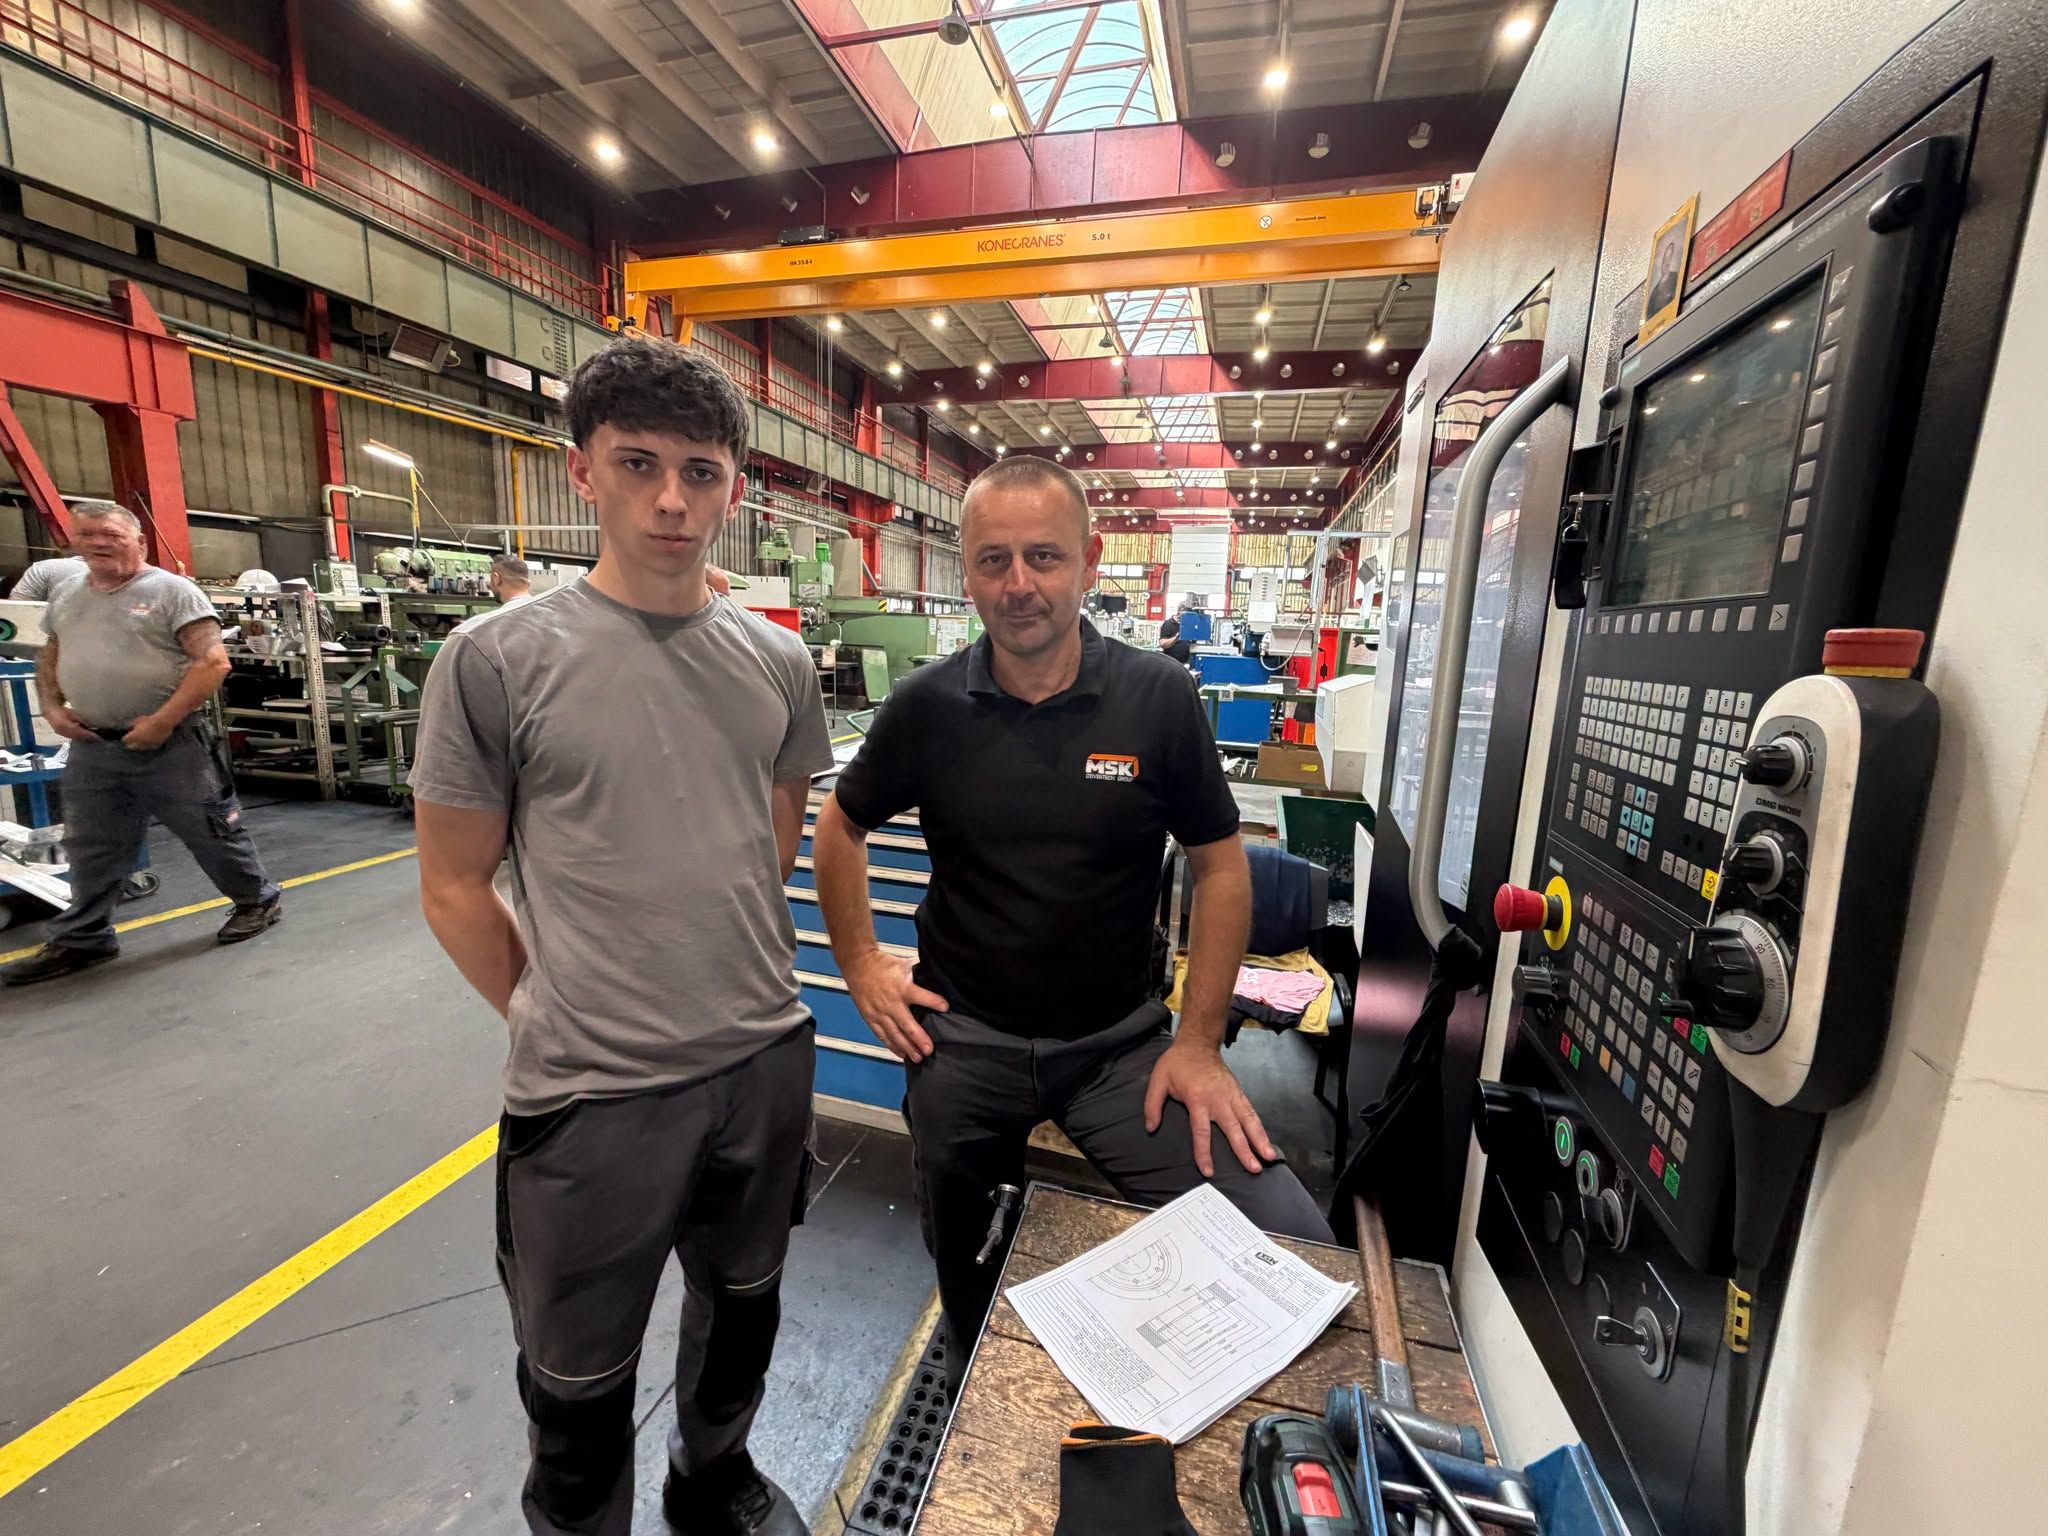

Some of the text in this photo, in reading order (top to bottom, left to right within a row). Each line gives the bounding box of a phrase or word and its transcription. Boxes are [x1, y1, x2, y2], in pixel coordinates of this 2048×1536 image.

[977, 234, 1064, 252] KONECRANES
[1092, 233, 1105, 241] 5.0
[1085, 759, 1134, 777] MSK
[1755, 798, 1777, 809] DMG
